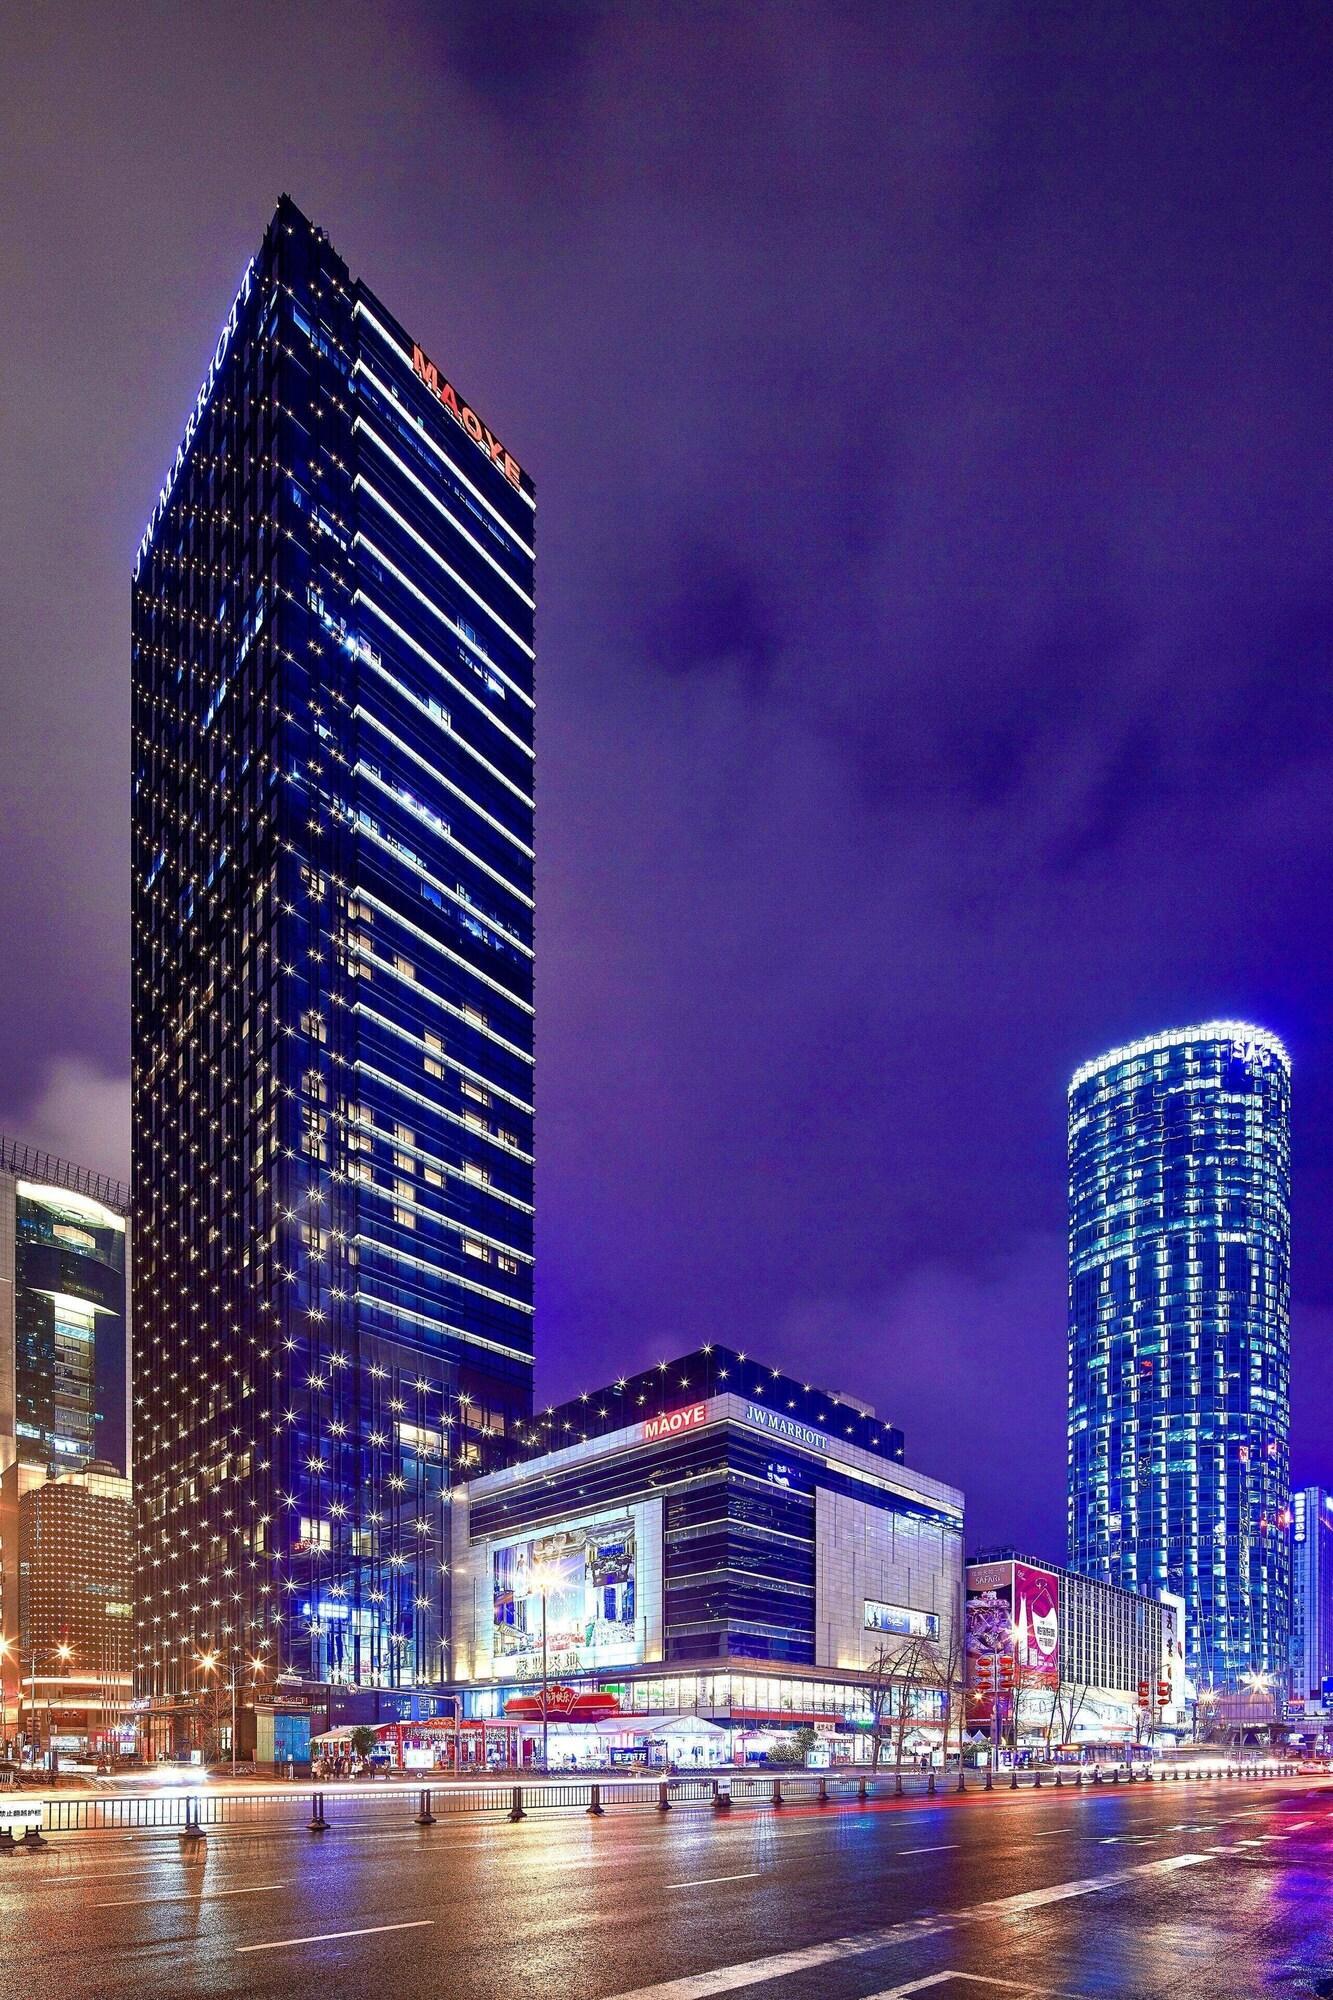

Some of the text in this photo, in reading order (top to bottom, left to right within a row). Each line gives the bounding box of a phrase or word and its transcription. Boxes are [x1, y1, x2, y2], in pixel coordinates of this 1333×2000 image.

[133, 256, 255, 582] JW MARRIOTT
[411, 344, 522, 492] MAOYE
[644, 1404, 705, 1439] MAOYE
[747, 1405, 828, 1450] JW MARRIOTT
